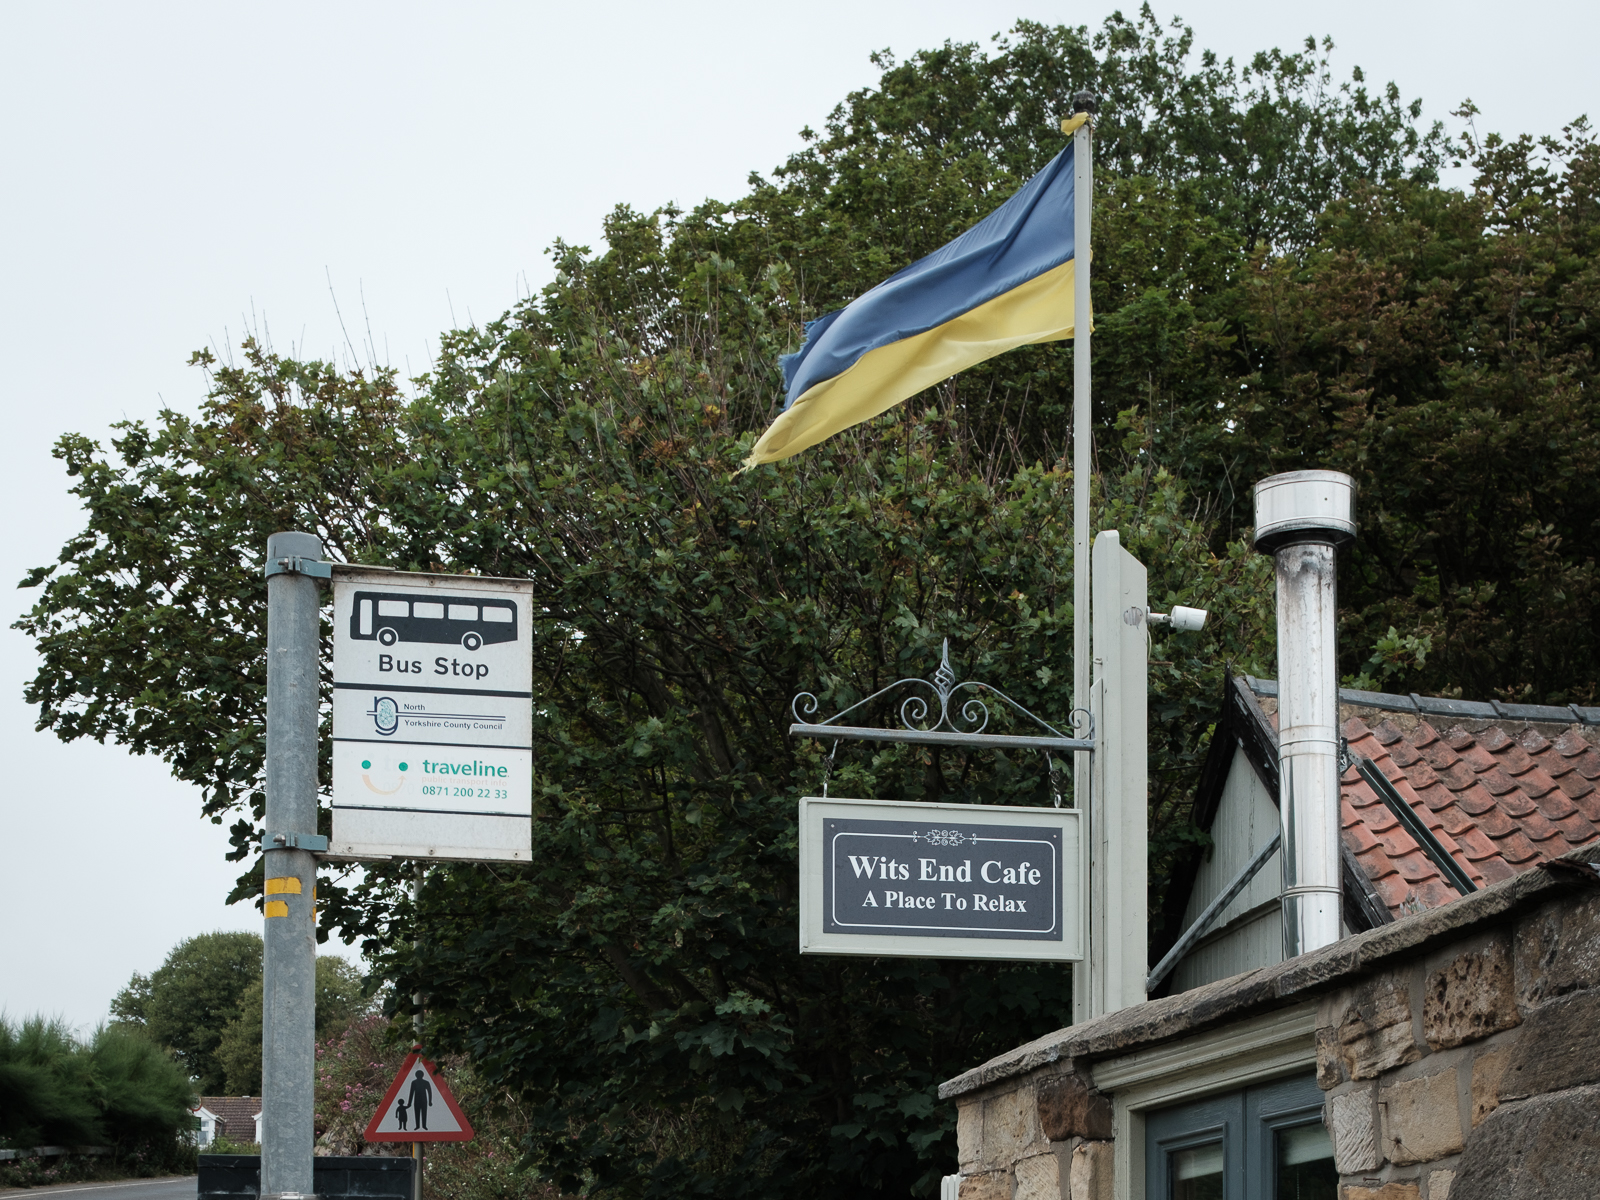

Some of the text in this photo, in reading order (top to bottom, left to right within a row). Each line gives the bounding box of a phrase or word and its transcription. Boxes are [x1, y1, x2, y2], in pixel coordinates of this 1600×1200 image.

[379, 654, 488, 680] Bus Stop
[404, 703, 425, 711] North
[405, 719, 502, 731] Yorkshire County Council
[423, 760, 507, 777] traveline
[422, 775, 446, 784] public
[450, 778, 488, 787] transport
[423, 785, 448, 796] 0871
[454, 787, 473, 798] 200
[478, 788, 490, 799] 22
[495, 789, 507, 800] 33
[848, 856, 1040, 885] Wits End Cafe
[862, 890, 1027, 912] A Place To Relax
